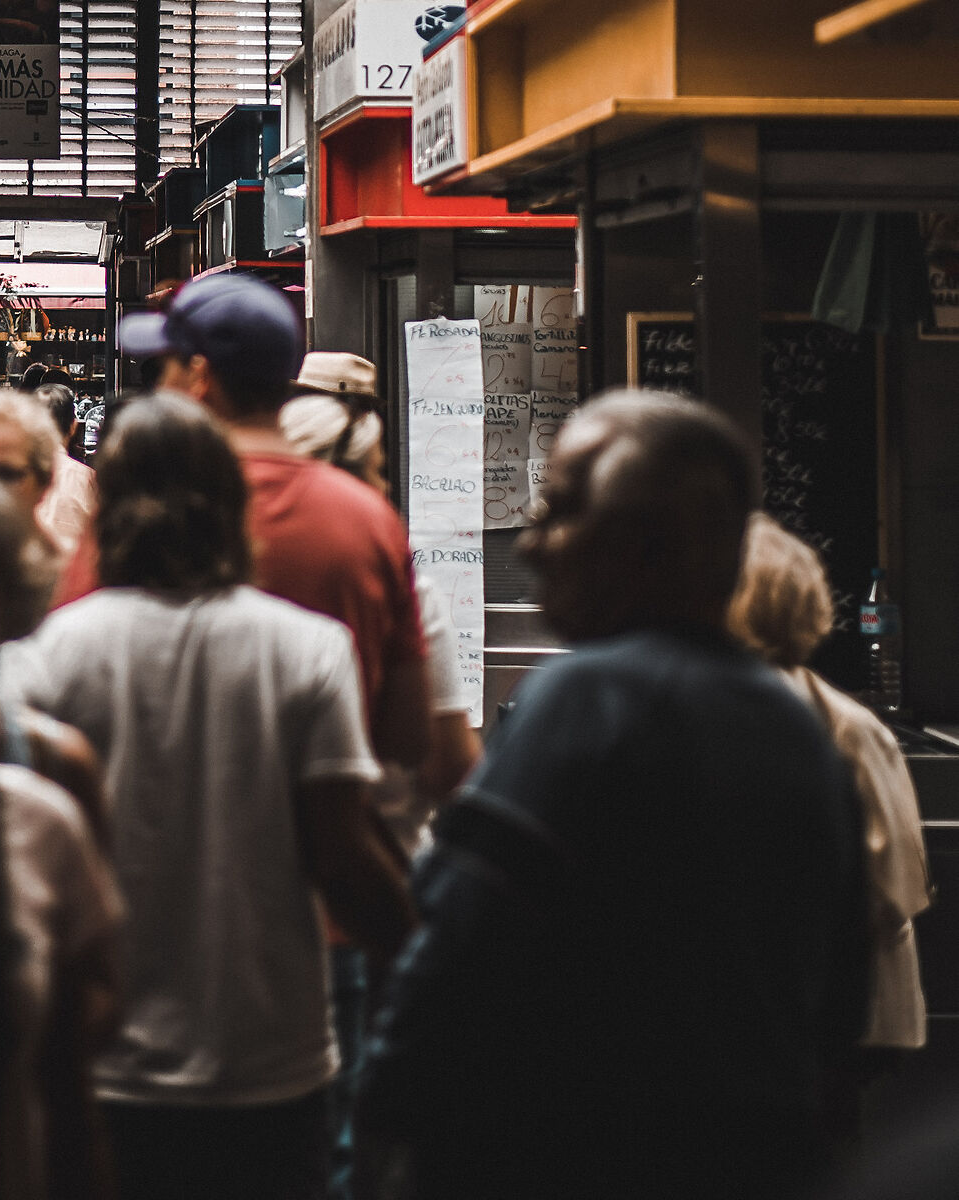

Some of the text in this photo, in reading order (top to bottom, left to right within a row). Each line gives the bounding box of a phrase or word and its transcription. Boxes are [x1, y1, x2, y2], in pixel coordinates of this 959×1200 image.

[361, 64, 412, 90] 127
[428, 323, 481, 338] ROSADA
[484, 394, 528, 410] OLITAS
[486, 407, 517, 419] APE
[430, 548, 484, 565] DORADA
